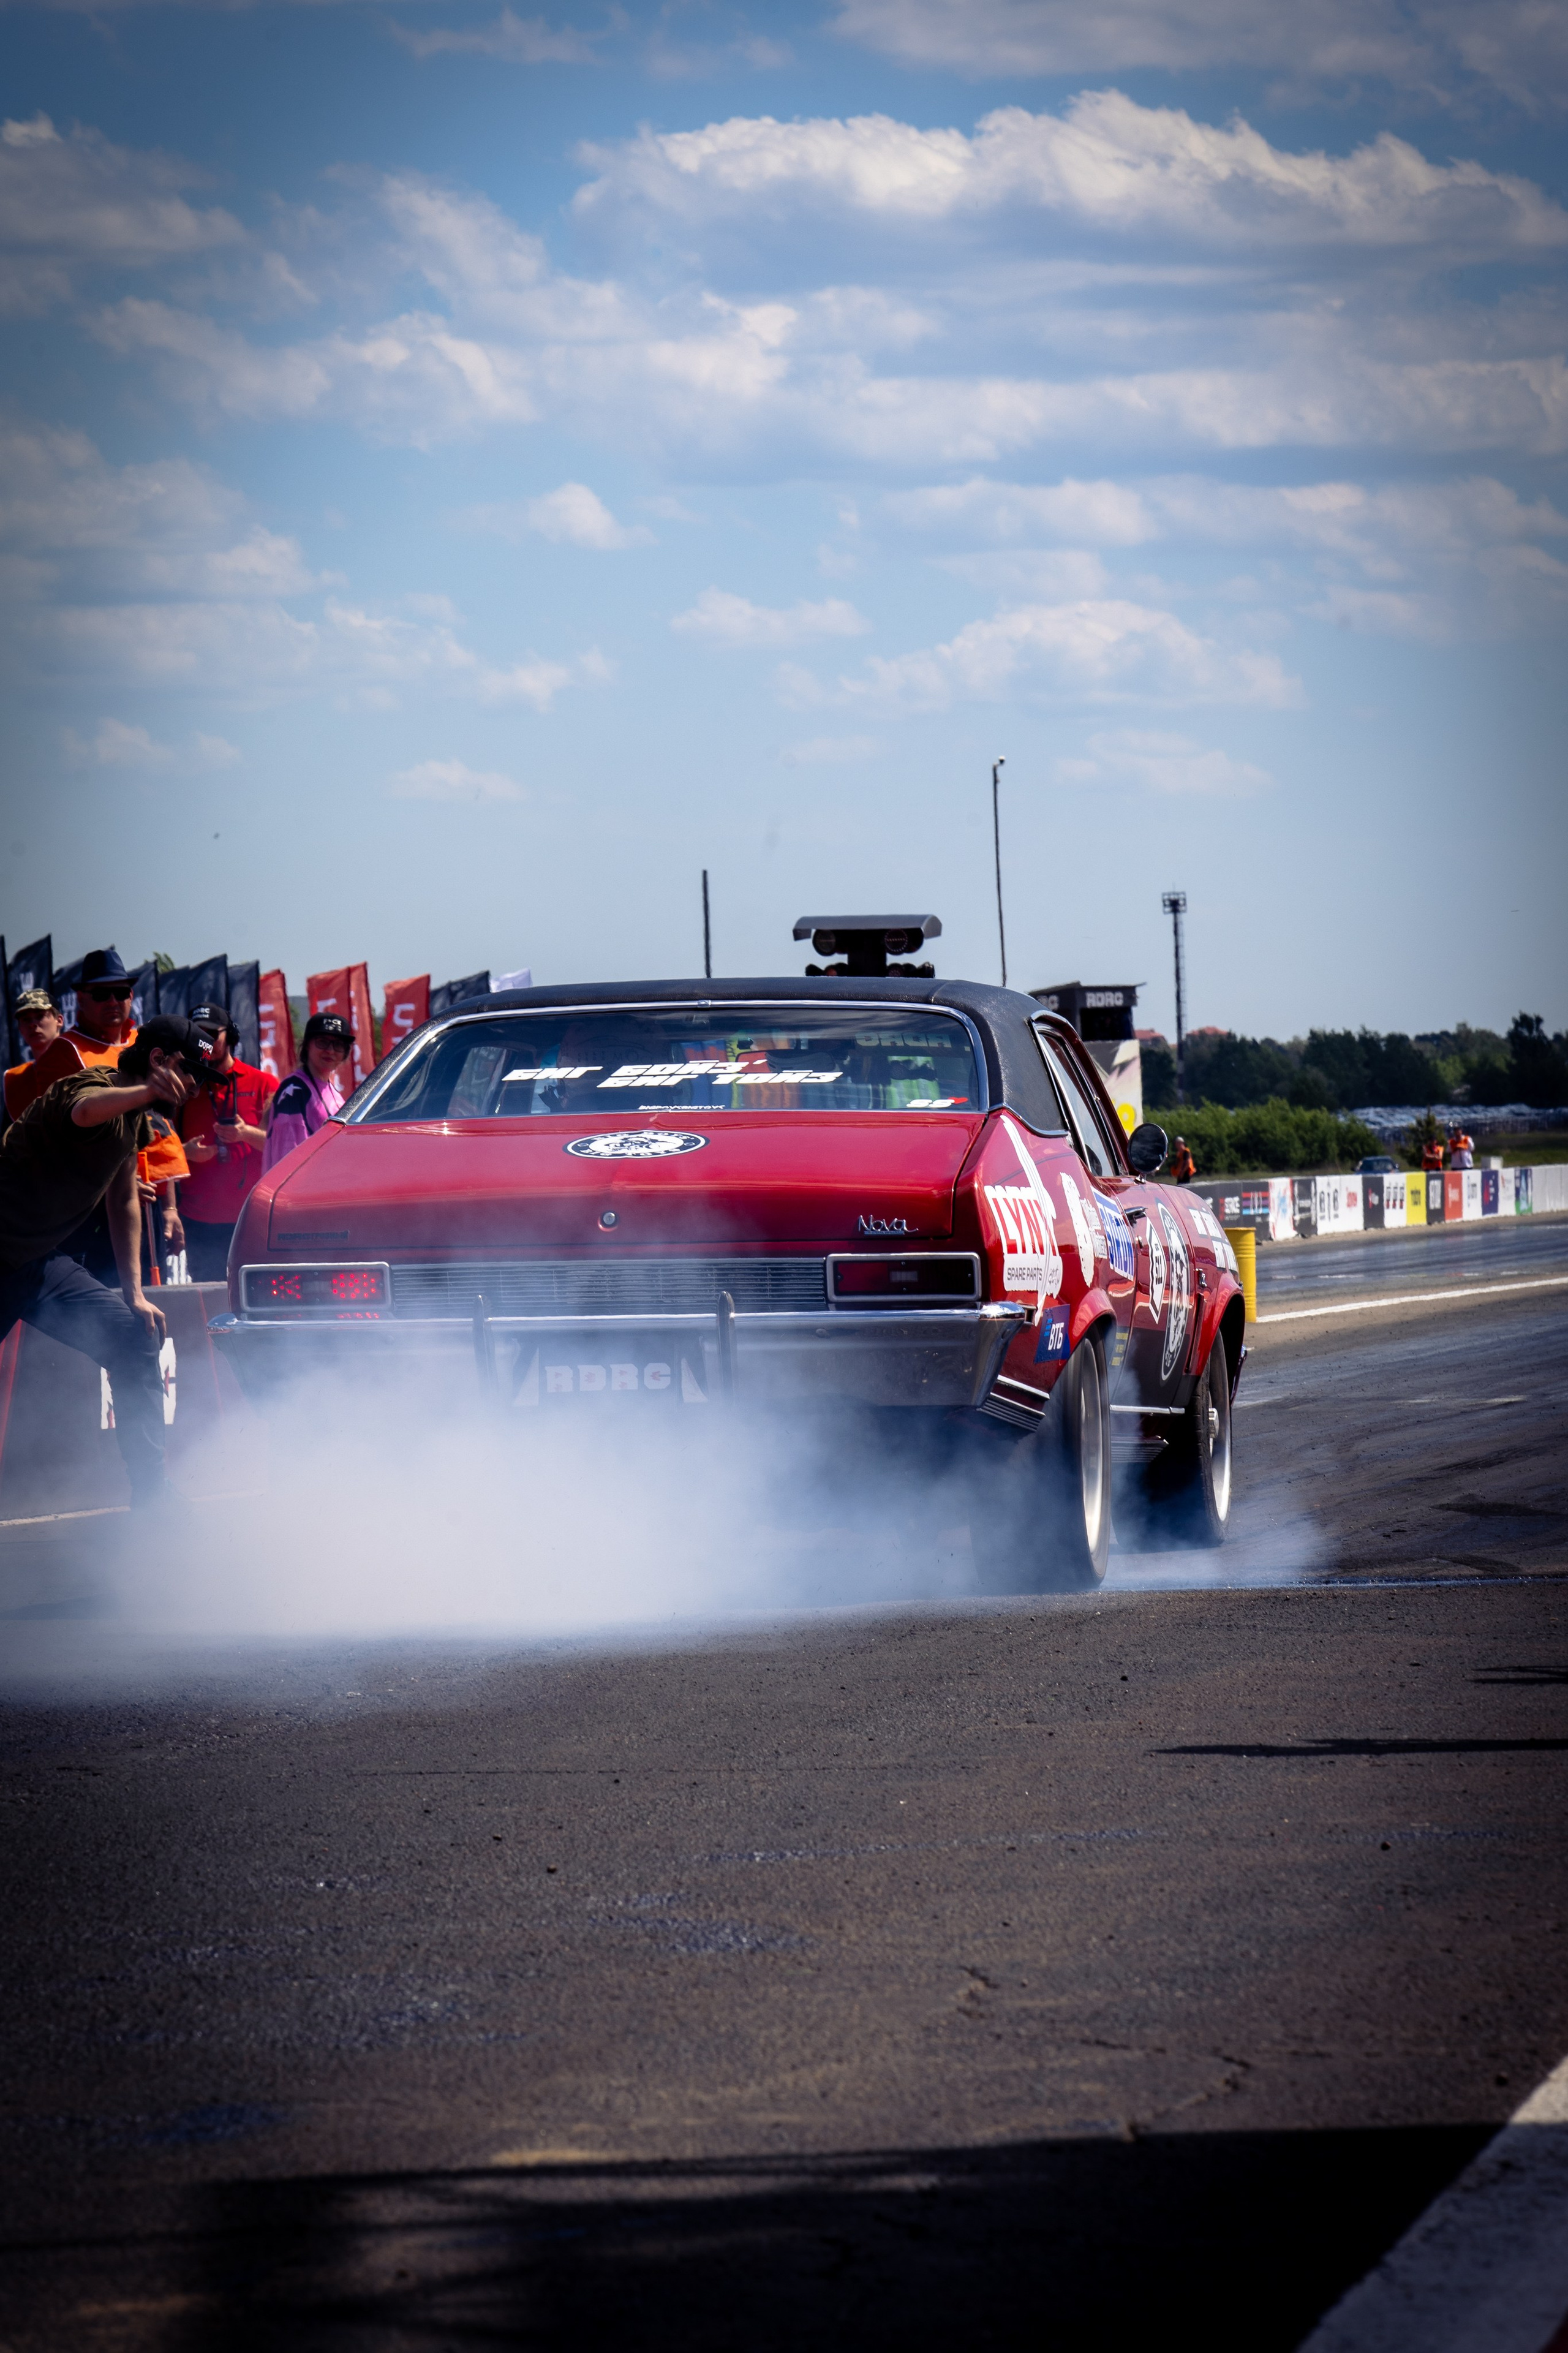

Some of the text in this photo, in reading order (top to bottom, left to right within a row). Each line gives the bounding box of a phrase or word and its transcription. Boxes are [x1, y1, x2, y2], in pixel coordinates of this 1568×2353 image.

[502, 1066, 603, 1081] БИГ
[597, 1070, 843, 1088] БИГ ТОЙЗ
[858, 1214, 919, 1233] Nova
[1007, 1267, 1042, 1281] SPARE PARTS
[545, 1362, 671, 1393] RDRC
